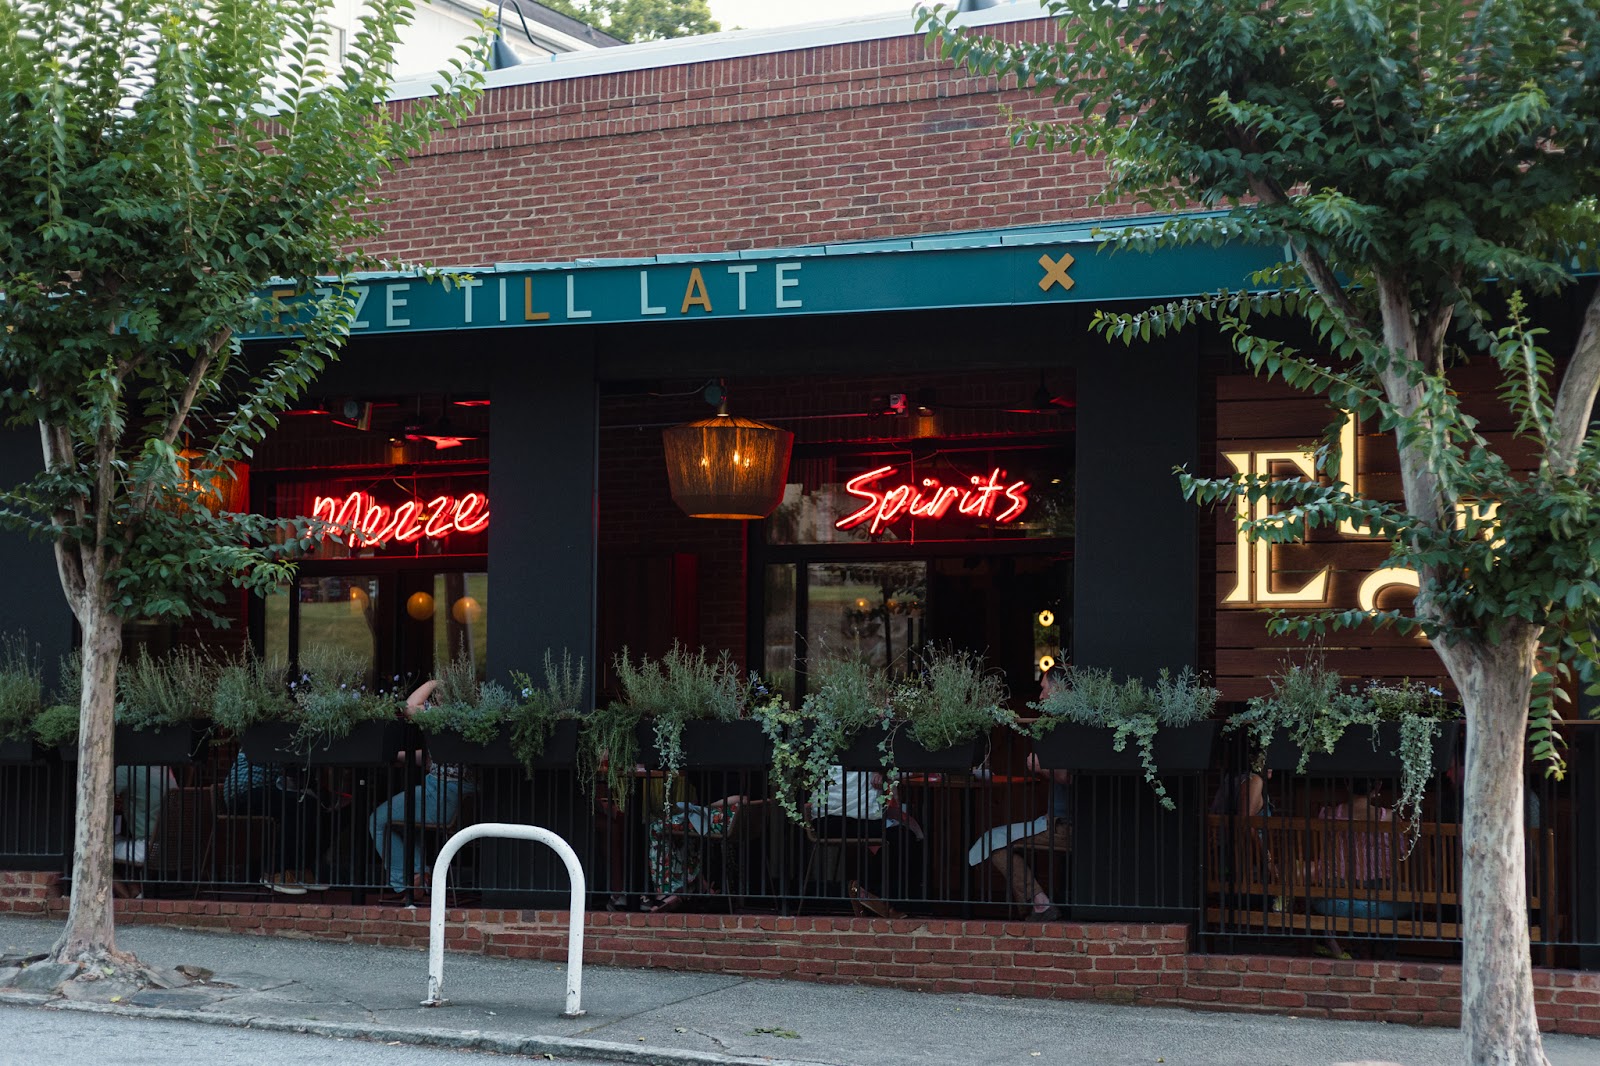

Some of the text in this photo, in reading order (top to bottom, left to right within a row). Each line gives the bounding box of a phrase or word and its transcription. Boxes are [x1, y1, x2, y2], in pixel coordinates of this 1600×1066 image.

[460, 274, 592, 323] TILL
[640, 262, 803, 315] LATE
[306, 491, 490, 547] Mezze
[835, 466, 1025, 533] Spirits
